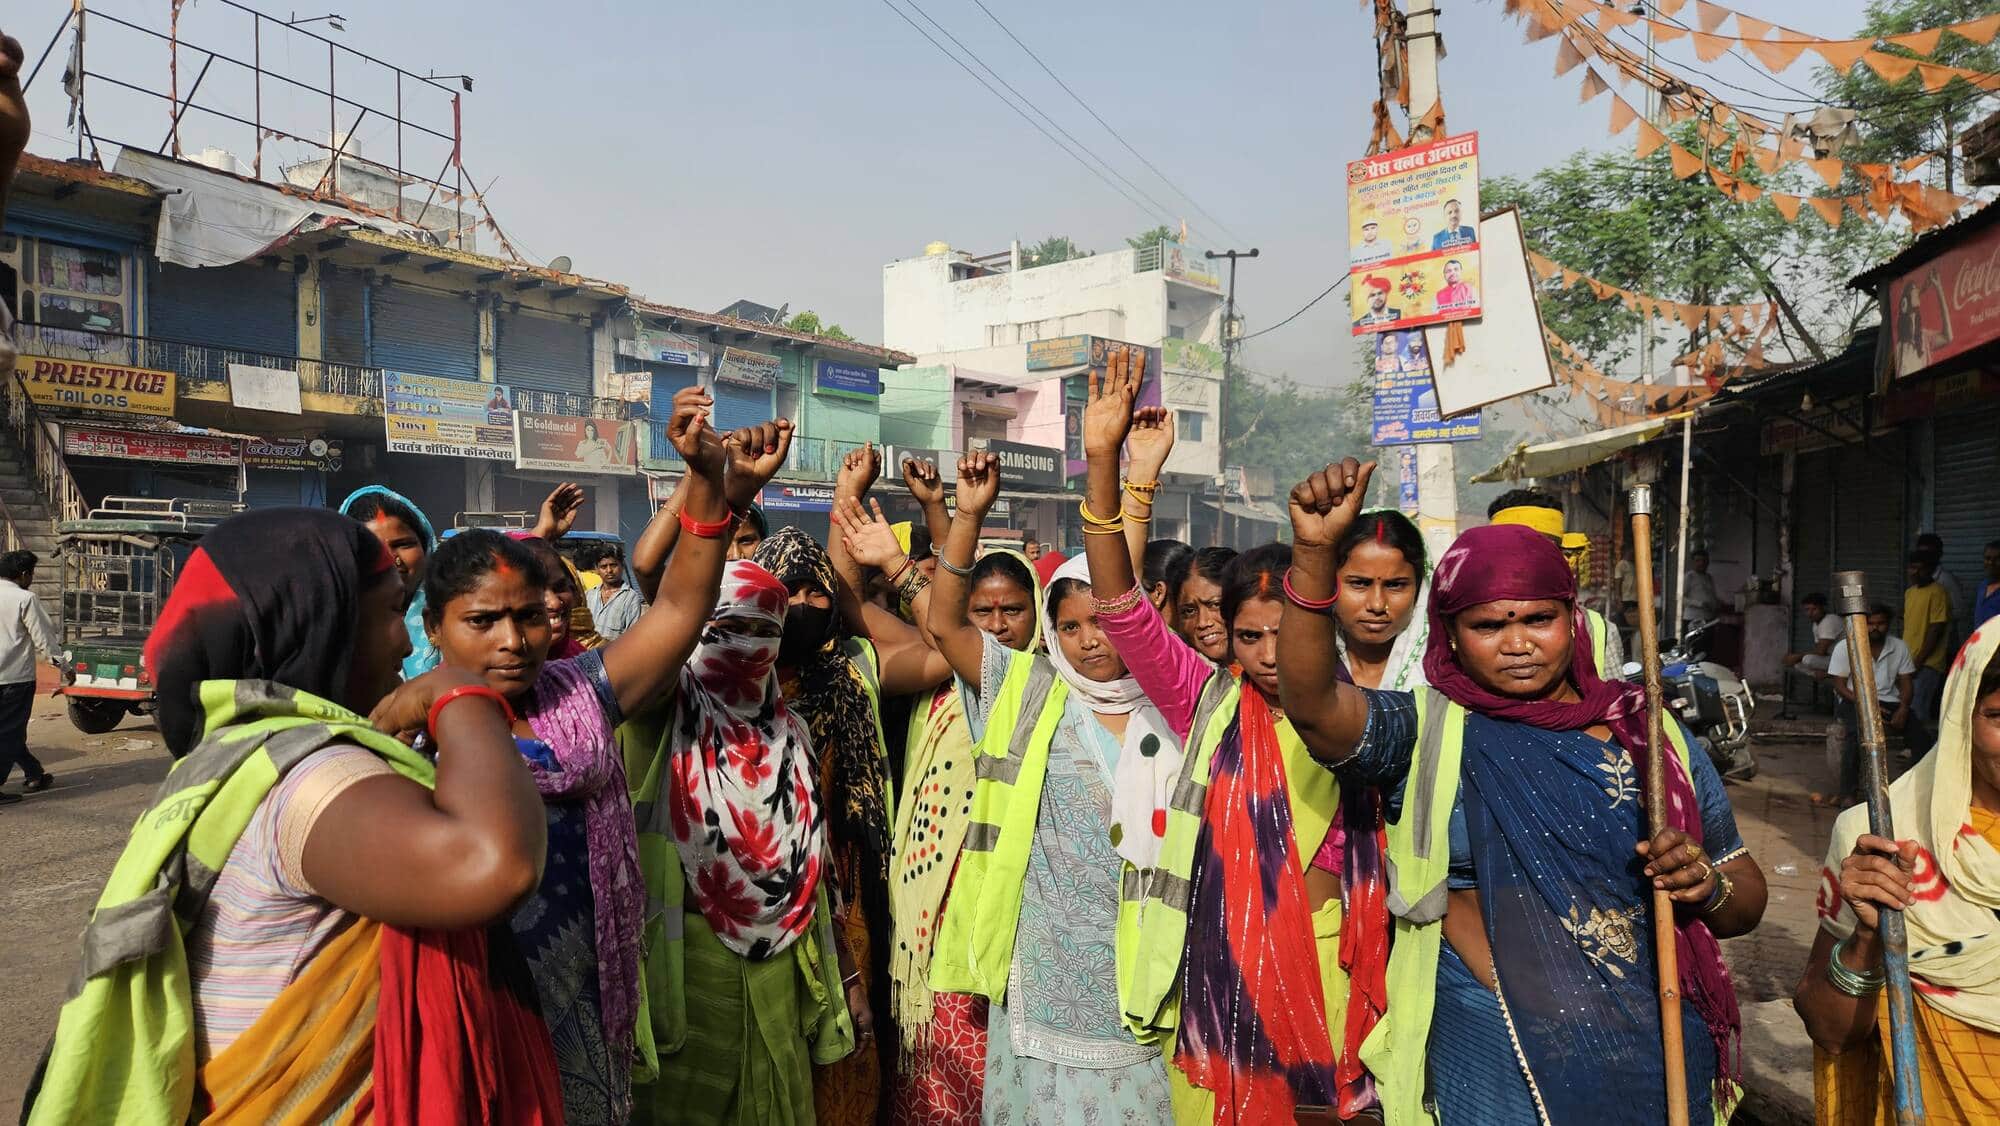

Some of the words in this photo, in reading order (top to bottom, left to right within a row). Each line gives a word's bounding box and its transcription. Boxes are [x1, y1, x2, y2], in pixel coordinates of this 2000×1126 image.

[1368, 160, 1391, 179] प्रेस
[1393, 151, 1425, 171] क्लब
[1428, 140, 1474, 164] अनपरा
[1953, 244, 2000, 311] Coca-Co
[32, 360, 167, 394] PRESTIGE
[53, 388, 129, 408] TAILORS
[534, 418, 577, 433] Goldmedal
[392, 441, 422, 452] स्वतंत्र
[1000, 451, 1055, 472] SAMSUNG
